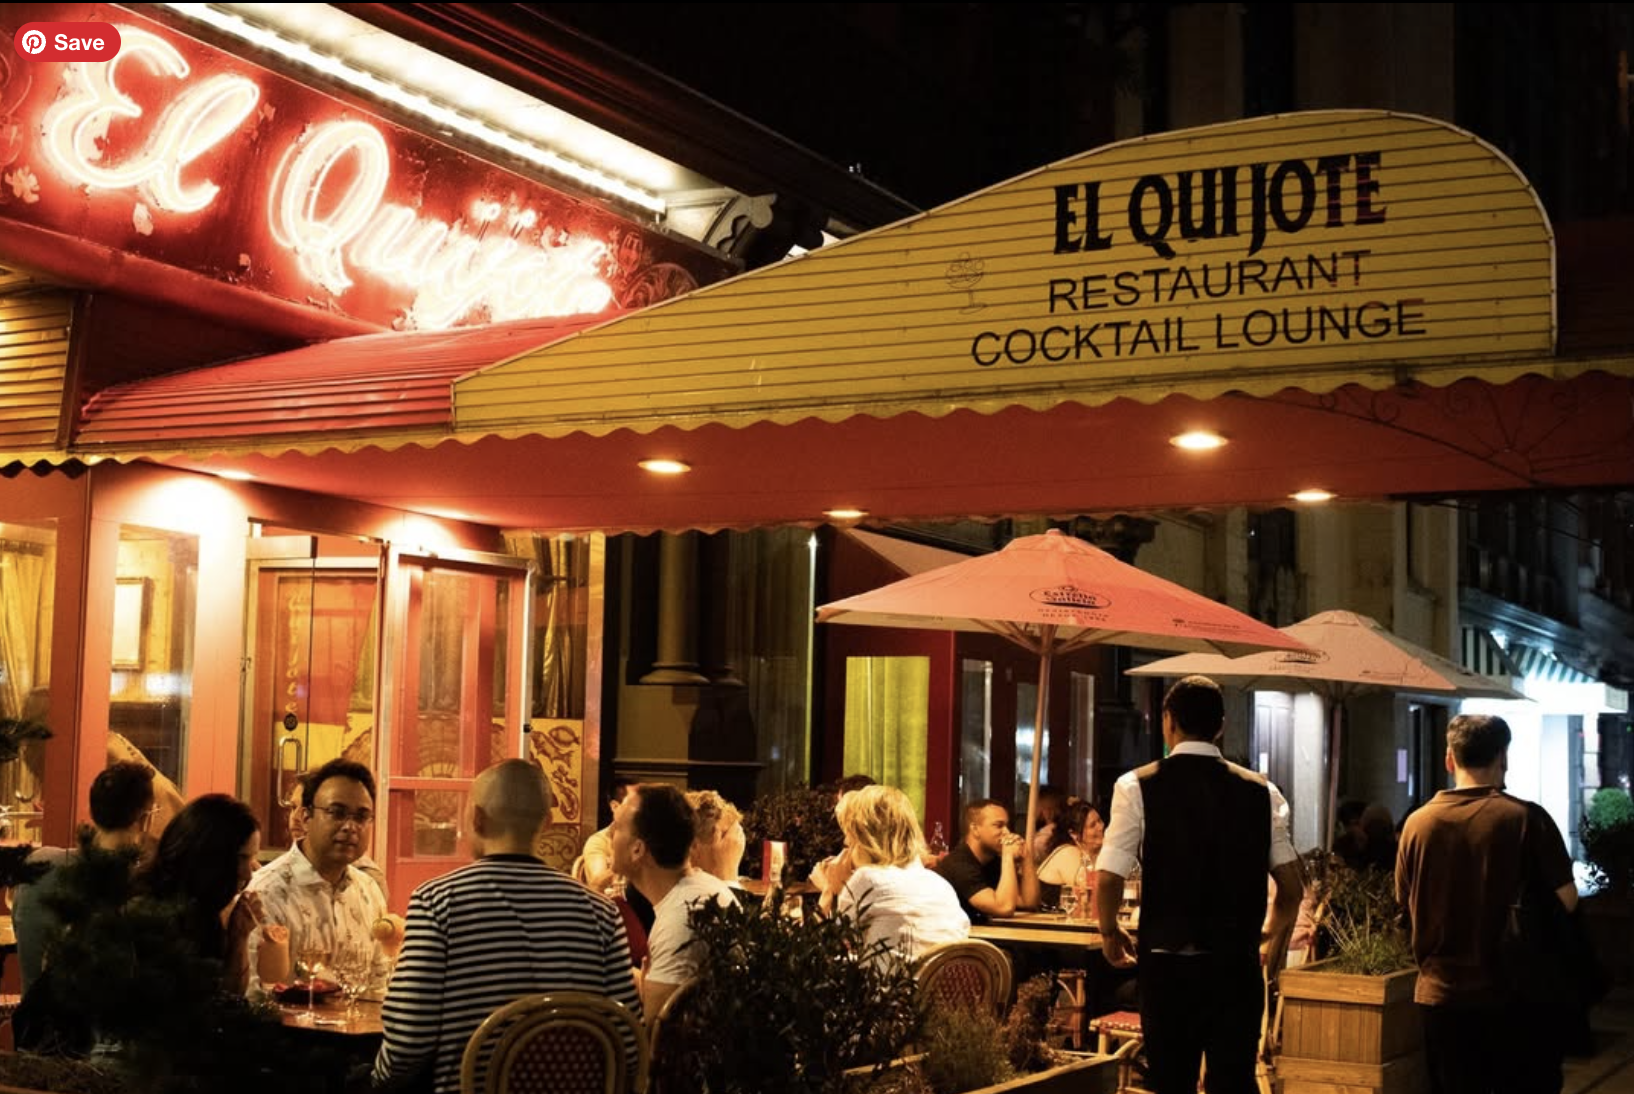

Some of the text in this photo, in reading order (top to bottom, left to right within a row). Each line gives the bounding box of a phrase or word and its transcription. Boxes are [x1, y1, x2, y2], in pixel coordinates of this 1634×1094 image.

[40, 23, 260, 213] El
[1053, 151, 1388, 260] EL QUIJOTE
[1049, 250, 1371, 313] RESTAURANT
[971, 298, 1427, 366] COCKTAIL LOUNGE
